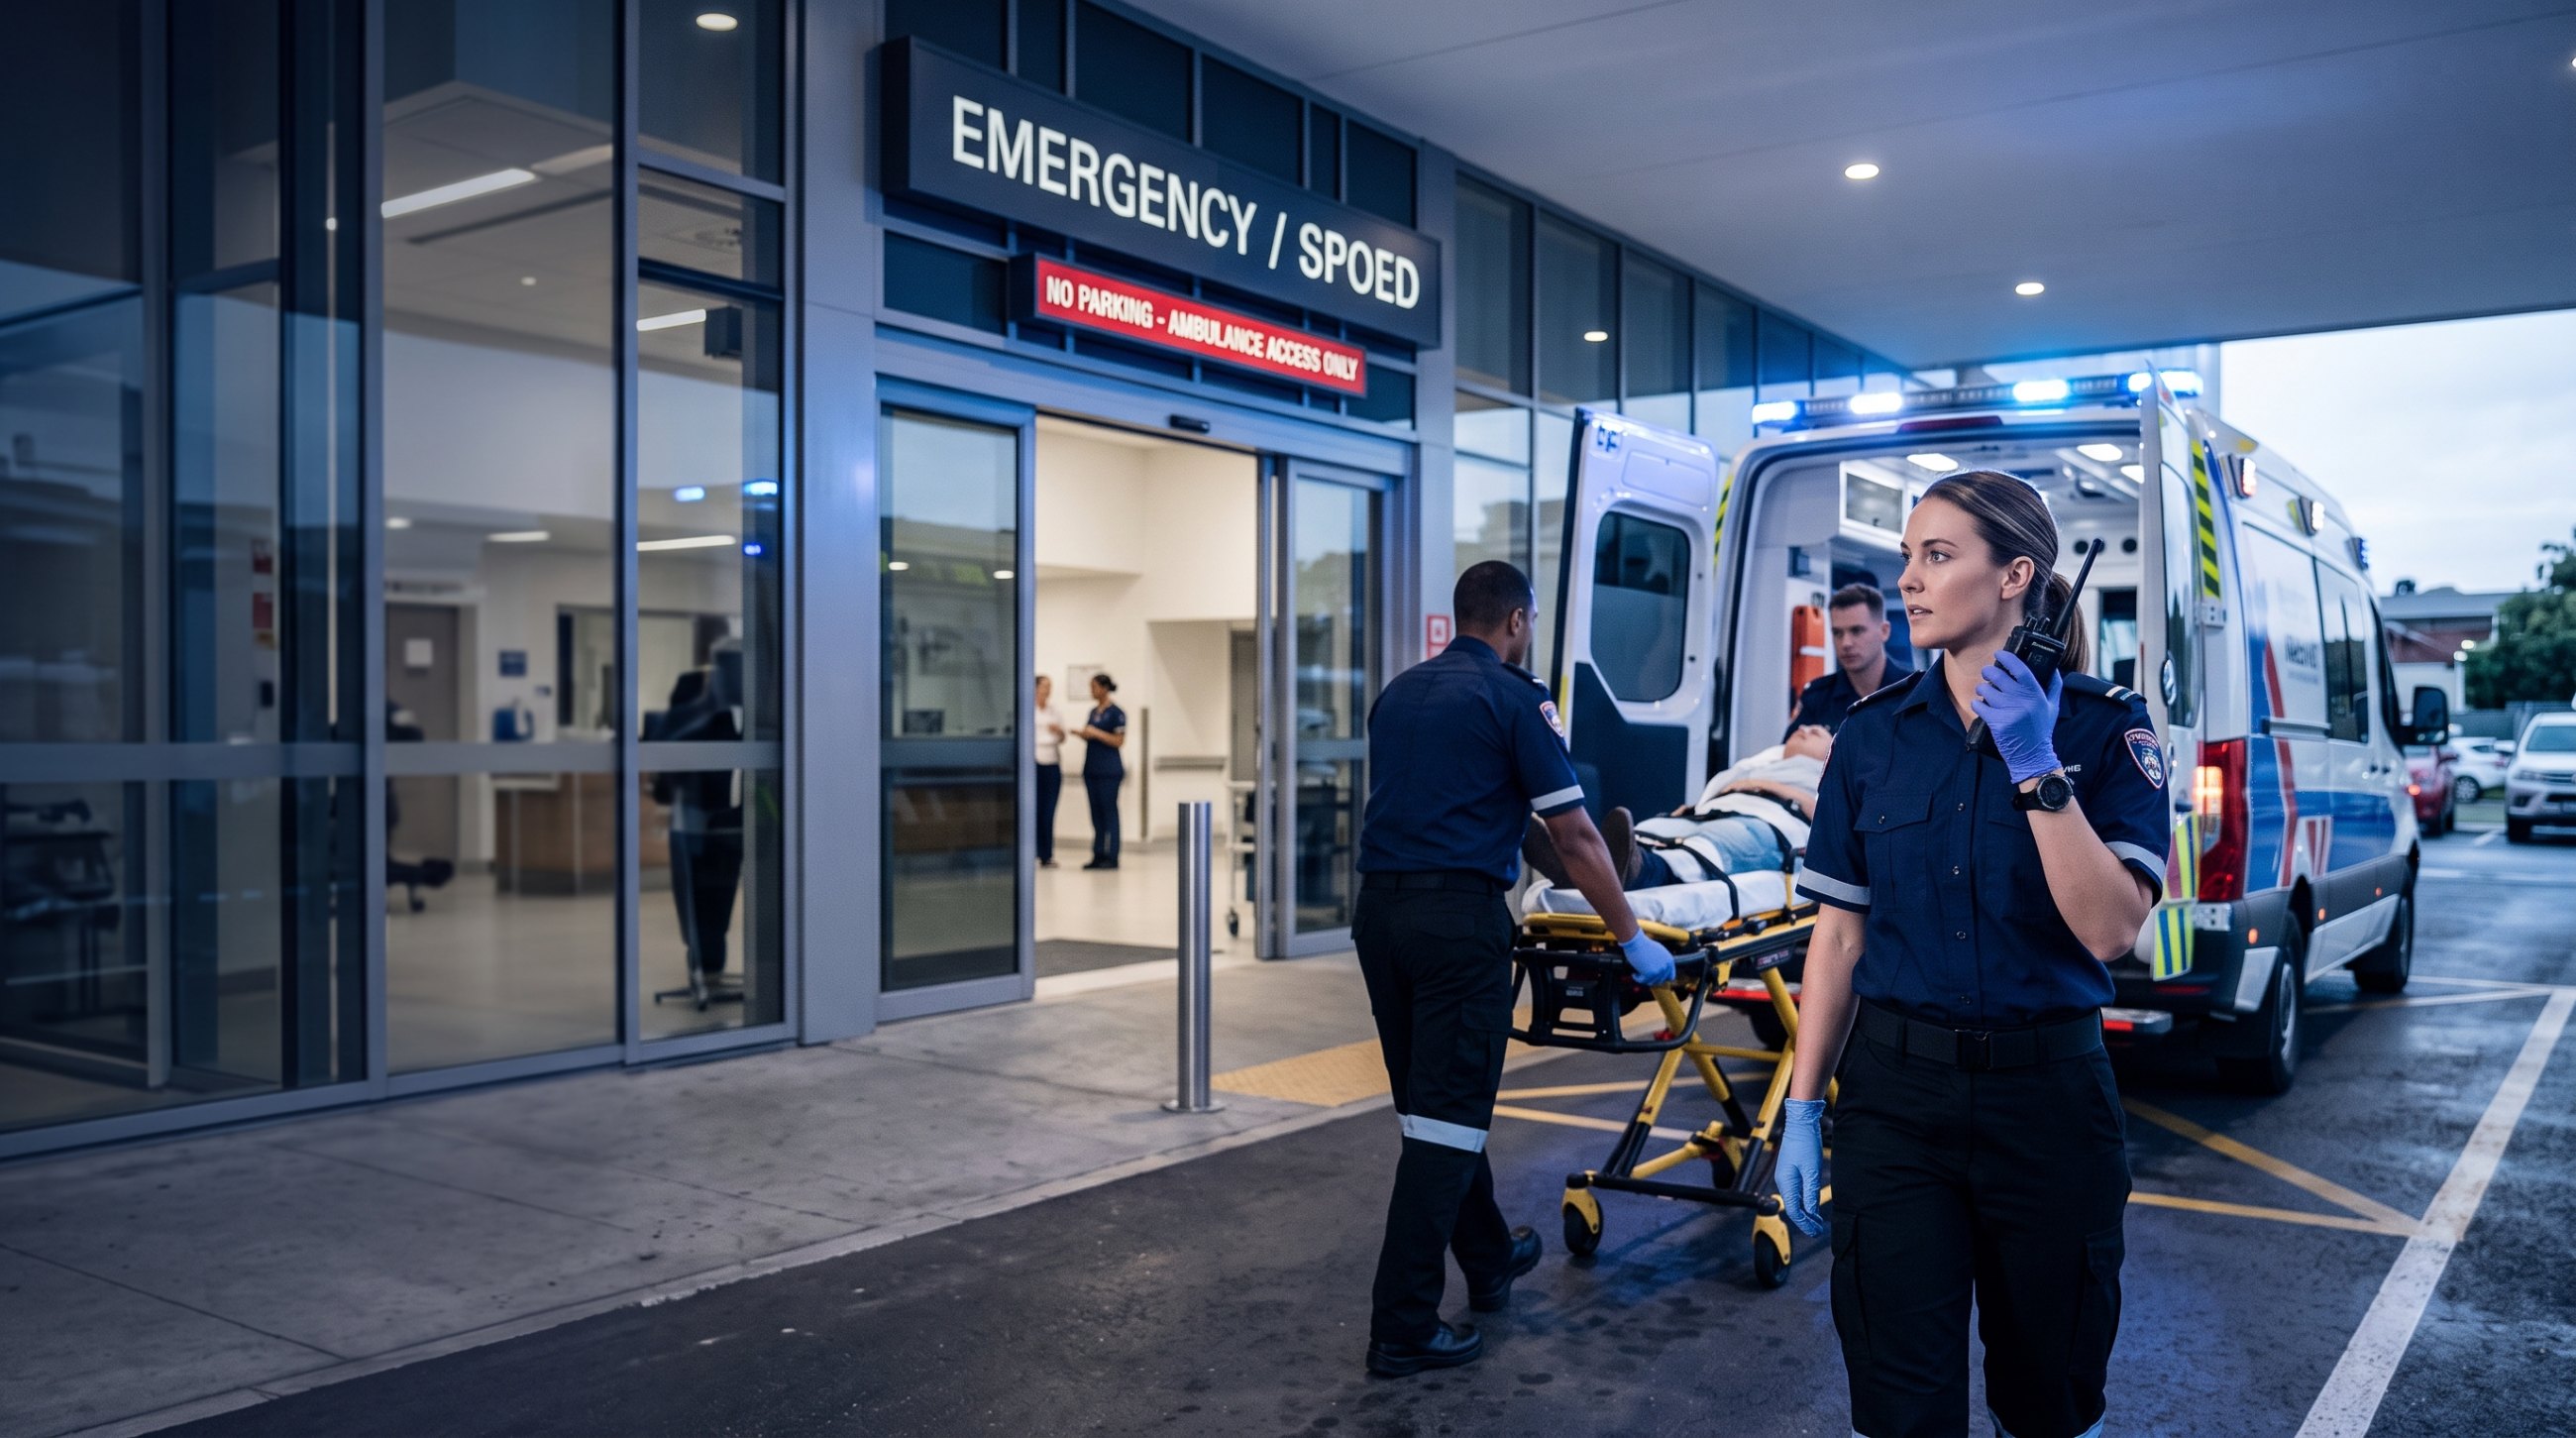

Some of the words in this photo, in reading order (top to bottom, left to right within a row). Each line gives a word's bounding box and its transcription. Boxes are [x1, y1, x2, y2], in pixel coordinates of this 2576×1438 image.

[952, 95, 1257, 256] EMERGENCY
[1268, 211, 1287, 270] /
[1298, 222, 1420, 310] SPOED
[1045, 275, 1075, 309] NO
[1077, 283, 1153, 329] PARKING
[1166, 308, 1265, 359] AMBULANCE
[1265, 335, 1323, 374] ACCESS
[1322, 350, 1359, 383] ONLY
